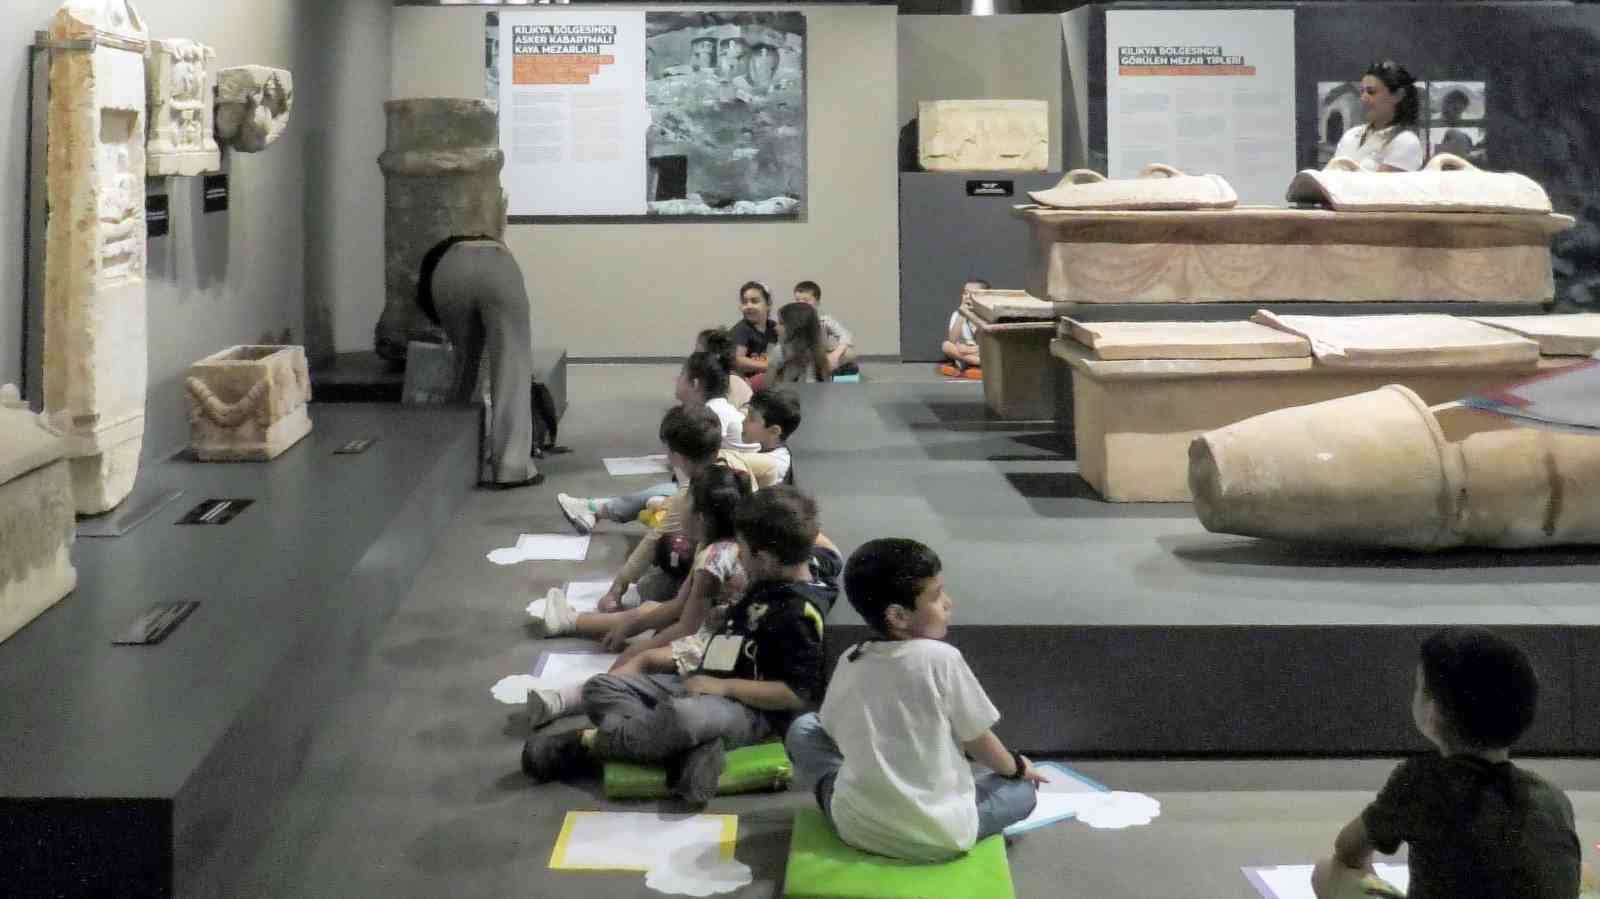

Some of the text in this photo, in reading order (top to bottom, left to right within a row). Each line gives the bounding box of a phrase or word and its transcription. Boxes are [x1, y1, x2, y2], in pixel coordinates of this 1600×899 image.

[515, 35, 547, 44] ASKER
[515, 45, 540, 54] KAYA
[1170, 56, 1204, 64] MEZAR
